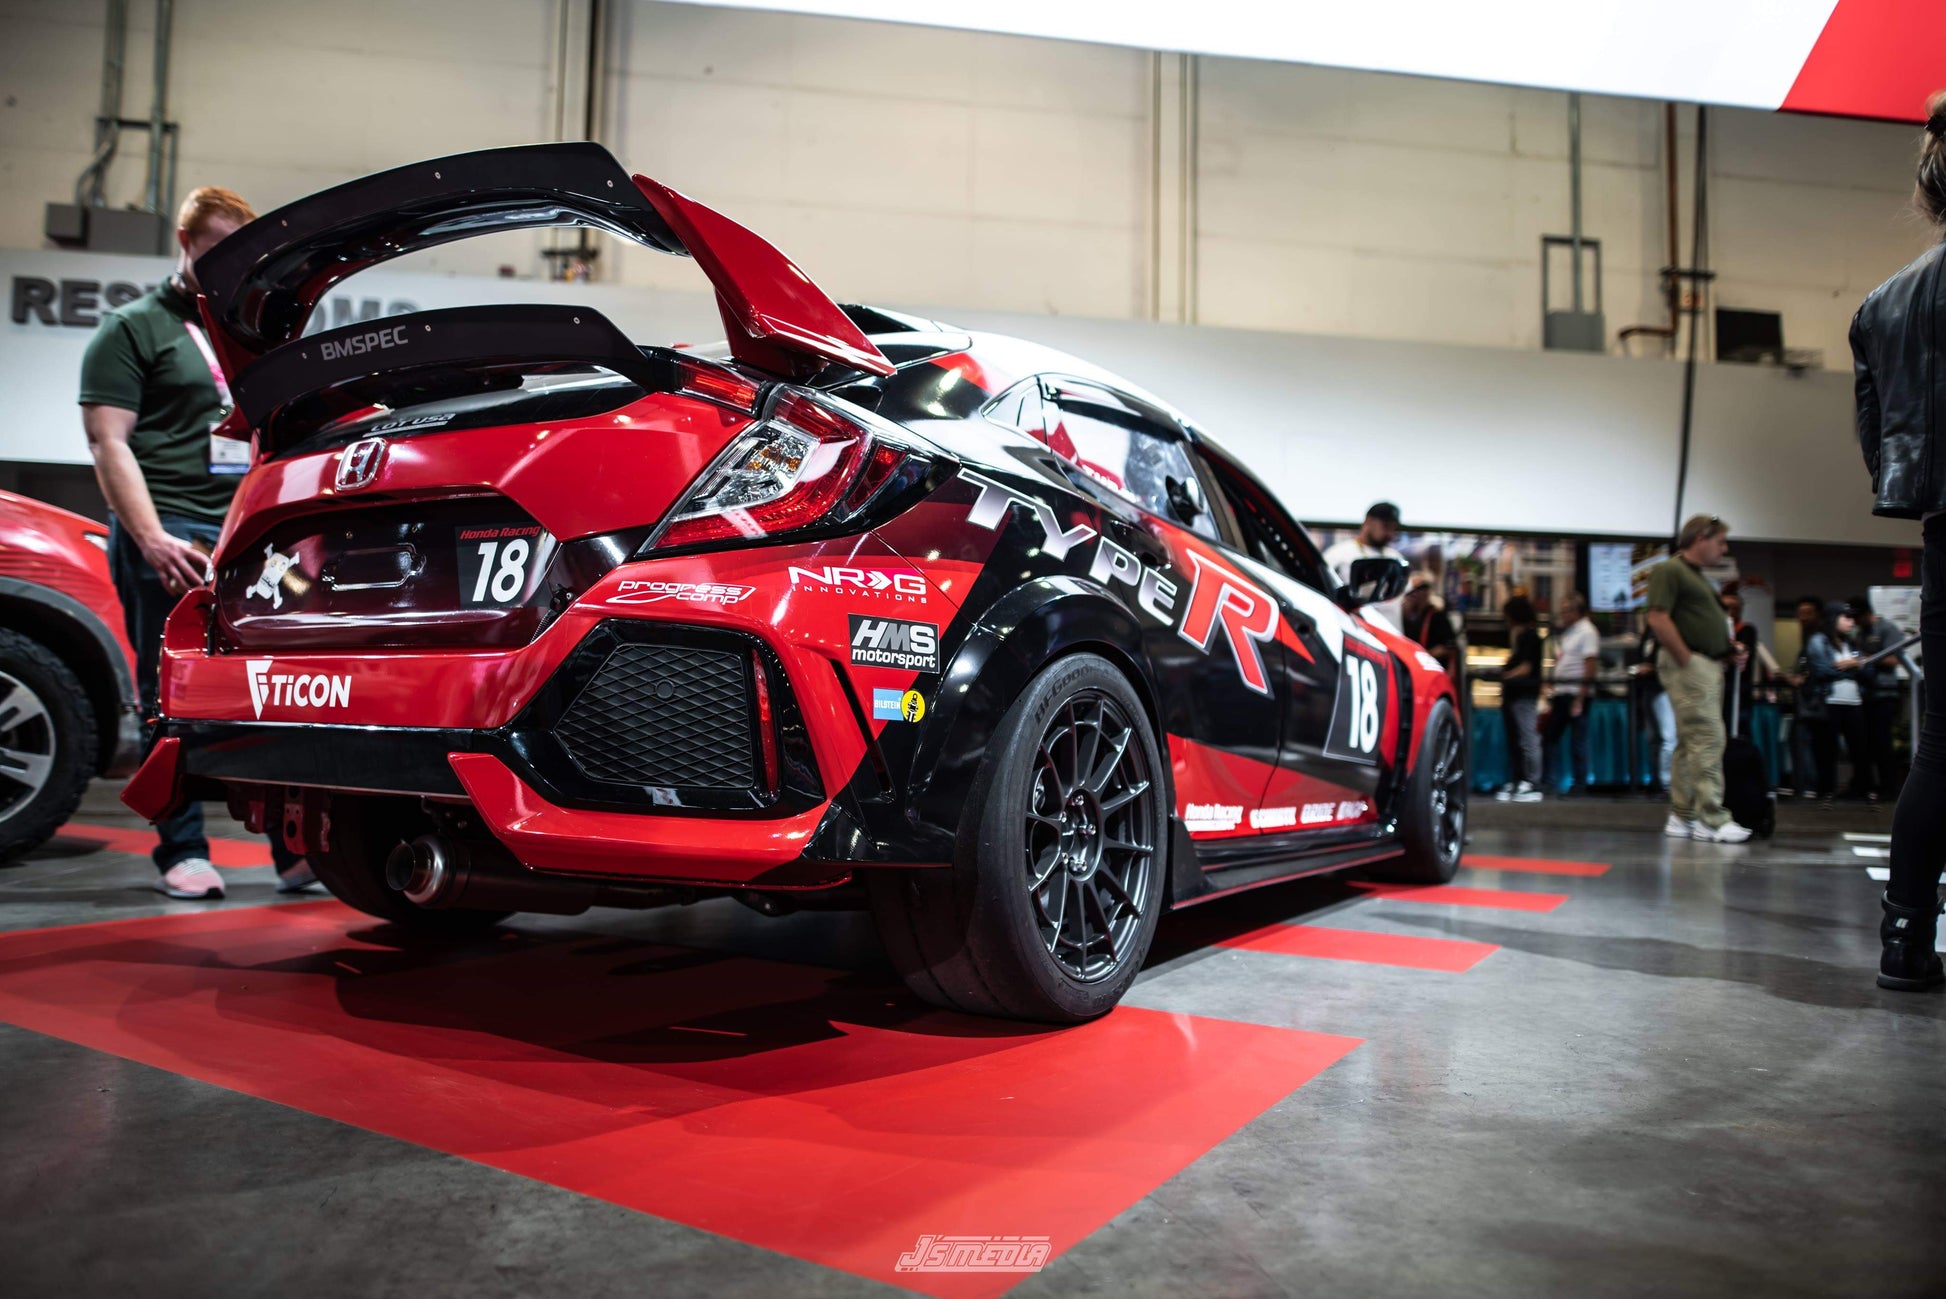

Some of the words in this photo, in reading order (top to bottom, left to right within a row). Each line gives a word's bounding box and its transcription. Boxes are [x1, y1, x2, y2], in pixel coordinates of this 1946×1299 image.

[320, 325, 409, 361] BMSPEC
[460, 527, 499, 540] Honda
[500, 525, 541, 538] Racing
[472, 538, 529, 603] 18
[618, 580, 743, 596] progress
[957, 467, 1178, 626] TYPE
[1177, 548, 1279, 699] R
[675, 592, 739, 605] comp
[792, 584, 927, 604] INNOVATIONS
[851, 619, 936, 655] HMS
[852, 648, 936, 669] motorsport
[874, 698, 902, 710] BILSTEIN
[1345, 653, 1379, 754] 18
